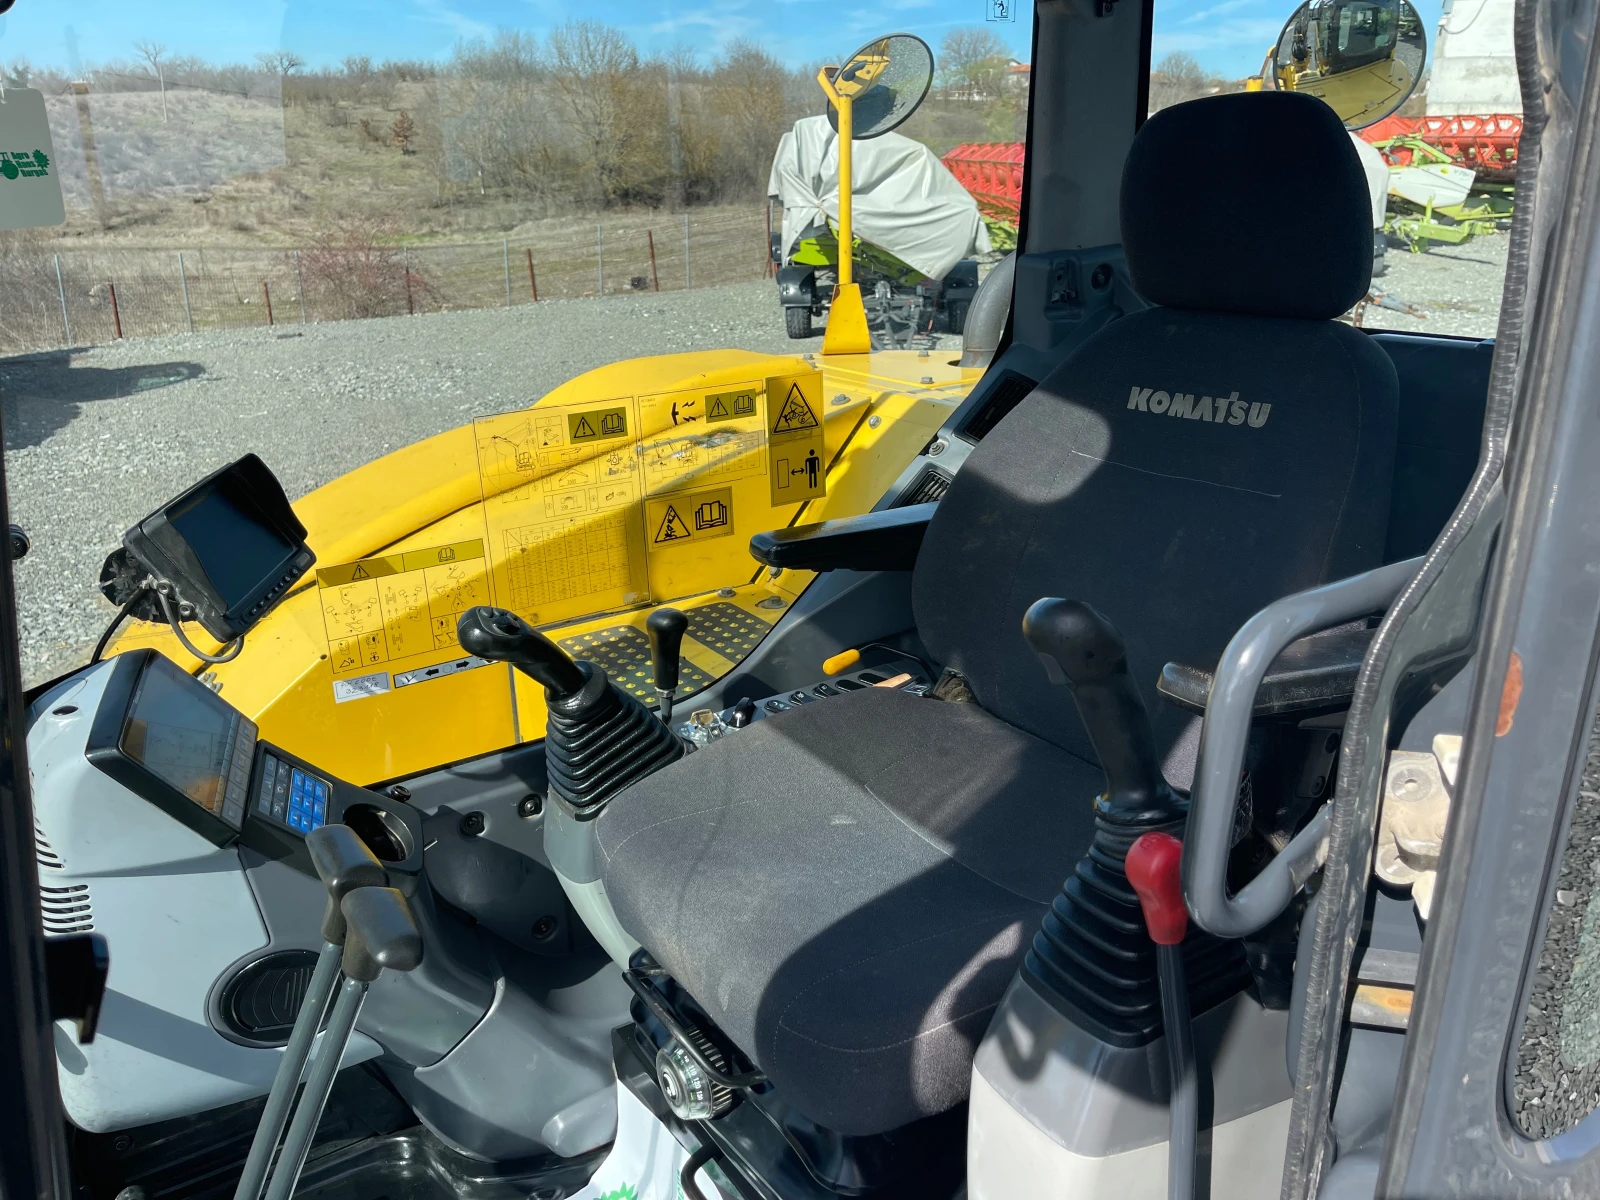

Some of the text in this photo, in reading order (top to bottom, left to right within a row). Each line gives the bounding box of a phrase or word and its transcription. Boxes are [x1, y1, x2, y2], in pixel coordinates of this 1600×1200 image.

[10, 152, 30, 160] Agro
[20, 169, 48, 177] Burgas
[1126, 386, 1272, 429] KOMATSU
[693, 1077, 702, 1089] 120
